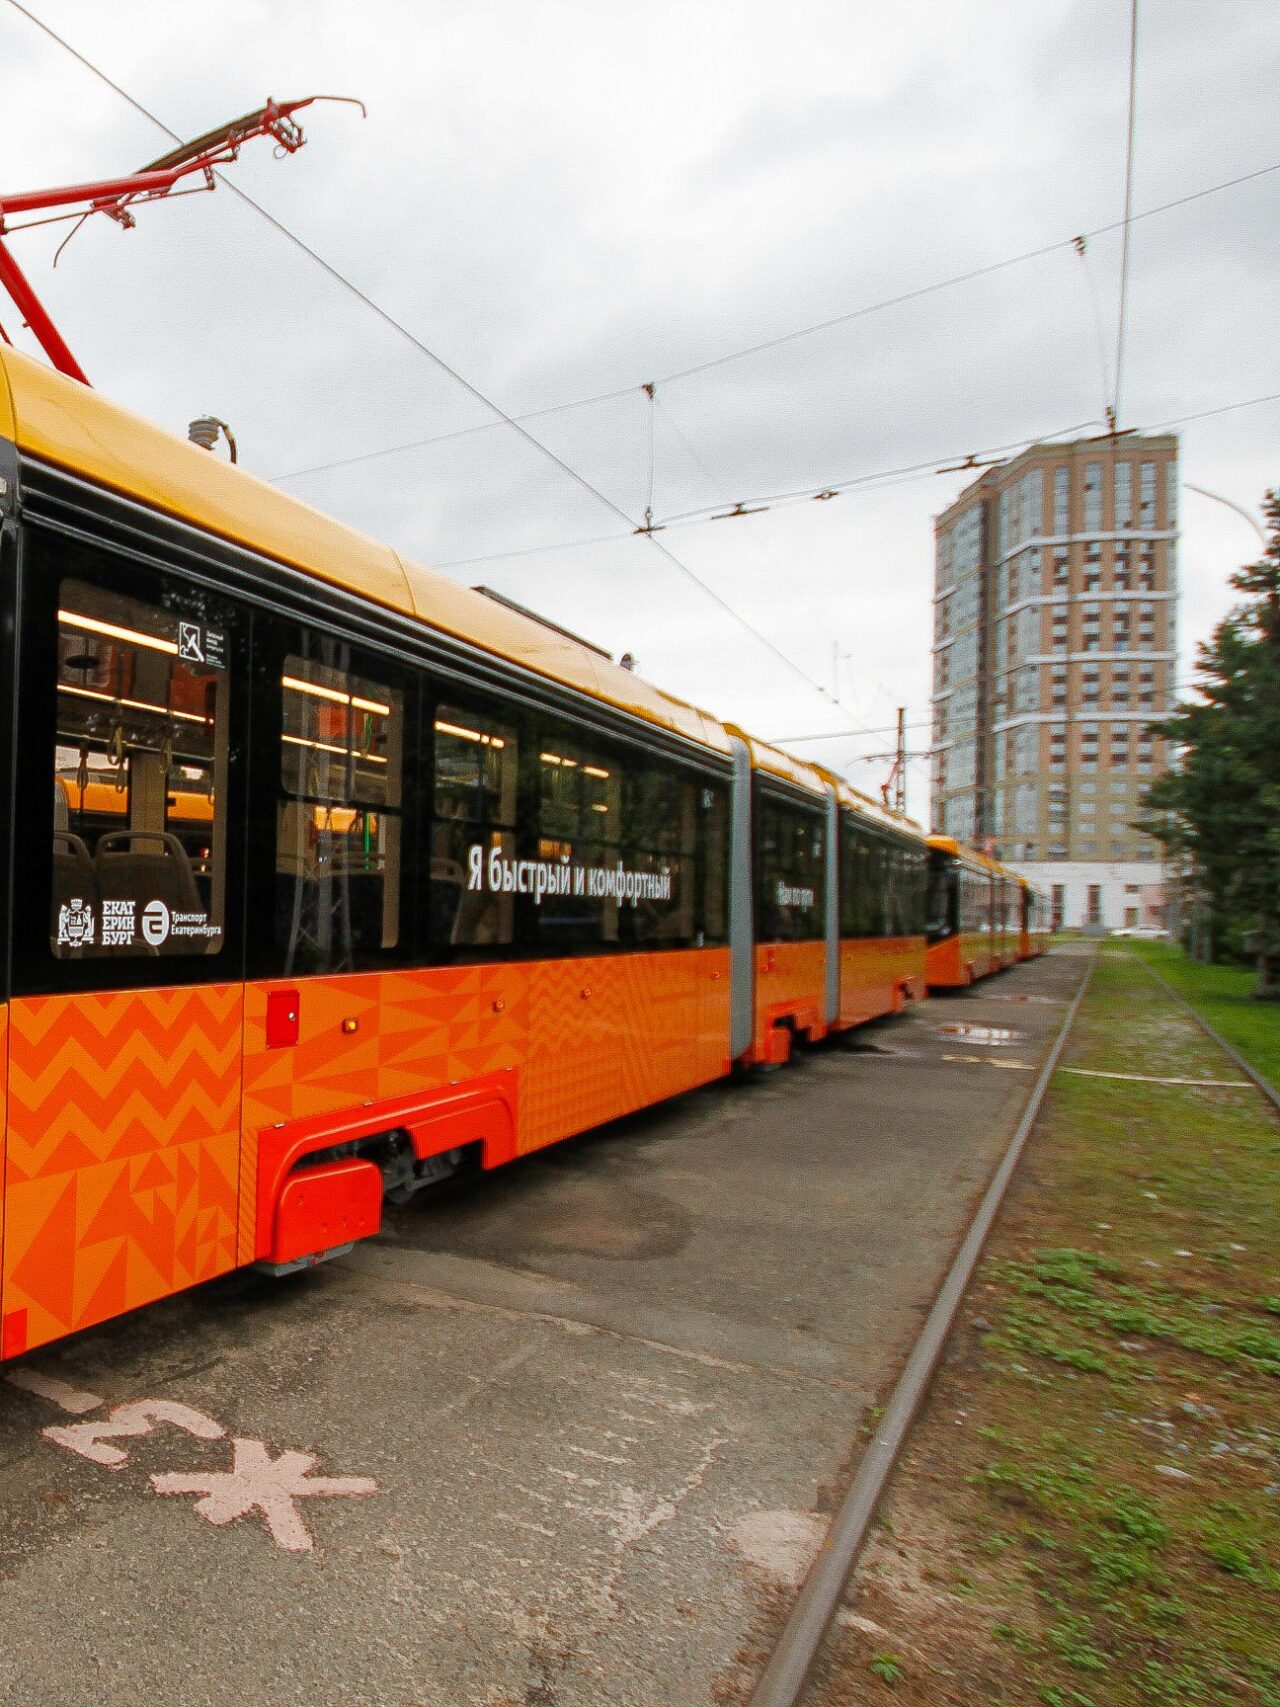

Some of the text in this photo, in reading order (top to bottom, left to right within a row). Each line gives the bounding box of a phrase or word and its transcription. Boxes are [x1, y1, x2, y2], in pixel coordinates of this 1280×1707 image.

[468, 845, 670, 907] Я быстрый и комфортный
[102, 900, 136, 915] ЕКАТ
[102, 916, 135, 930] ЕРИН
[171, 911, 207, 924] Транспорт
[171, 924, 221, 937] Екатеринбурга
[102, 931, 135, 945] БУРГ
